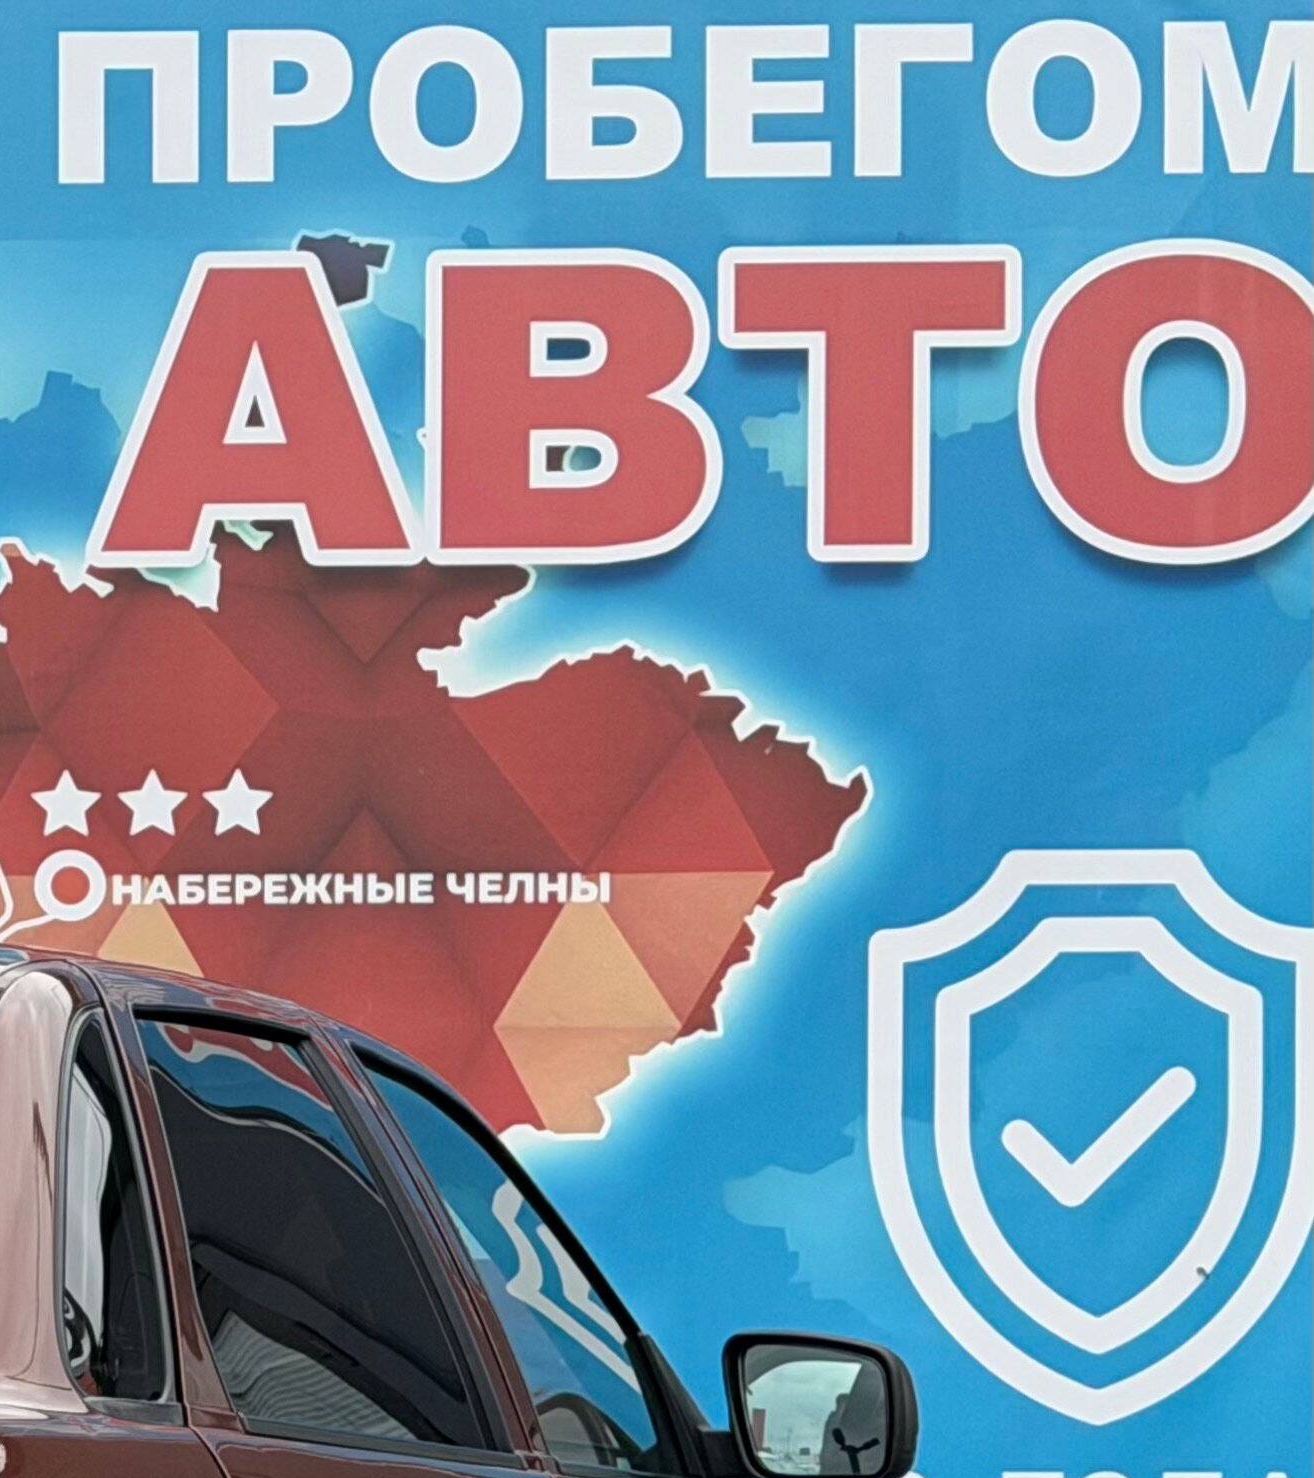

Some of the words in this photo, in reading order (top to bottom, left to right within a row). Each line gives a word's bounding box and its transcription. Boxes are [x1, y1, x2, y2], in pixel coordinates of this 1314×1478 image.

[58, 19, 1314, 184] ПРОБЕГОМ
[87, 238, 1314, 568] АВТО
[112, 872, 434, 906] НАБЕРЕЖНЫЕ
[446, 871, 612, 904] ЧЕЛНЫ
